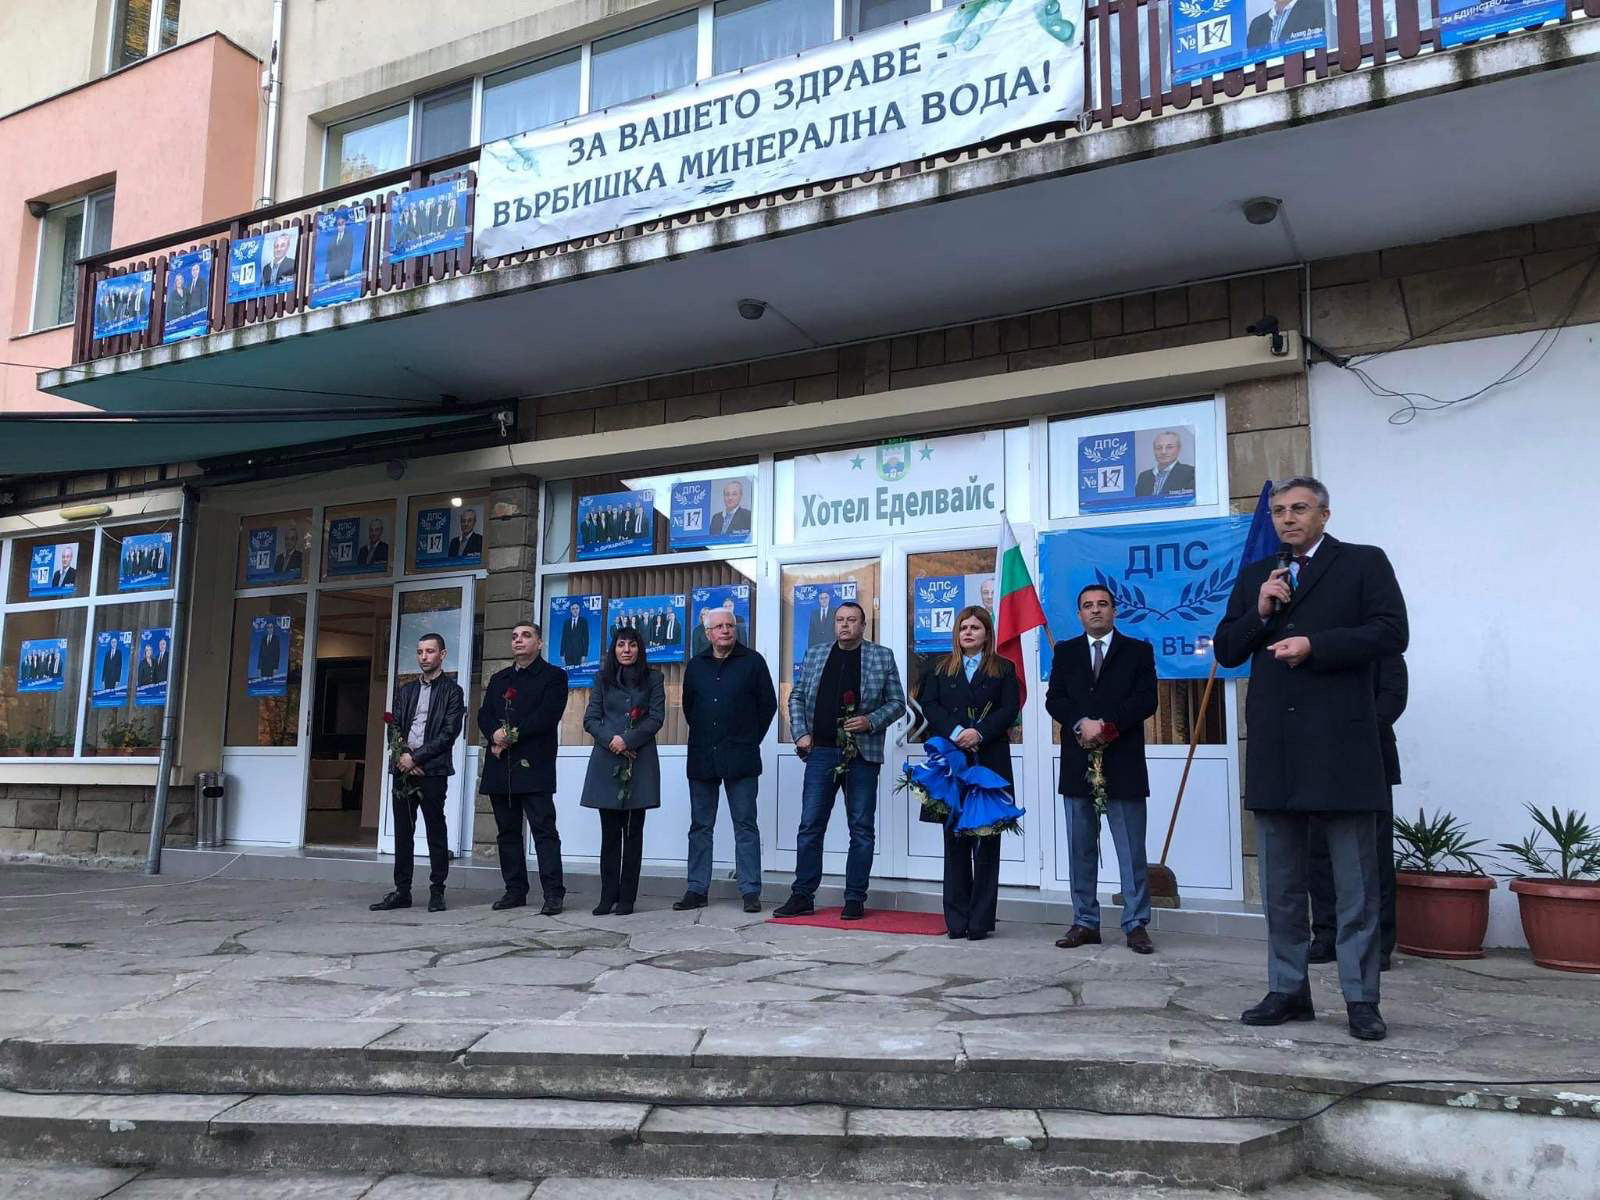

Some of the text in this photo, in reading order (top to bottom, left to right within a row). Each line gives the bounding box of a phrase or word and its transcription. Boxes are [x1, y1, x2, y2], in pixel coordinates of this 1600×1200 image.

[1201, 19, 1228, 47] 17
[567, 134, 607, 167] ЗА
[619, 89, 761, 152] ВАШЕТО
[772, 43, 922, 111] ЗДРАВЕ
[492, 60, 1053, 229] ВЪРБИШКА МИНЕРАЛНА ВОДА!
[242, 264, 254, 281] 17
[1094, 438, 1120, 450] ДПС
[1081, 468, 1121, 489] № 17
[682, 484, 701, 496] ДПС
[802, 474, 995, 528] Хотел Еделвайс
[685, 511, 701, 527] 17
[429, 535, 442, 551] 17
[258, 552, 269, 568] 17
[1125, 541, 1208, 580] ДПС
[843, 585, 855, 597] 17
[928, 581, 951, 592] ДПС
[935, 611, 953, 628] 17
[1162, 636, 1211, 655] ВЪР
